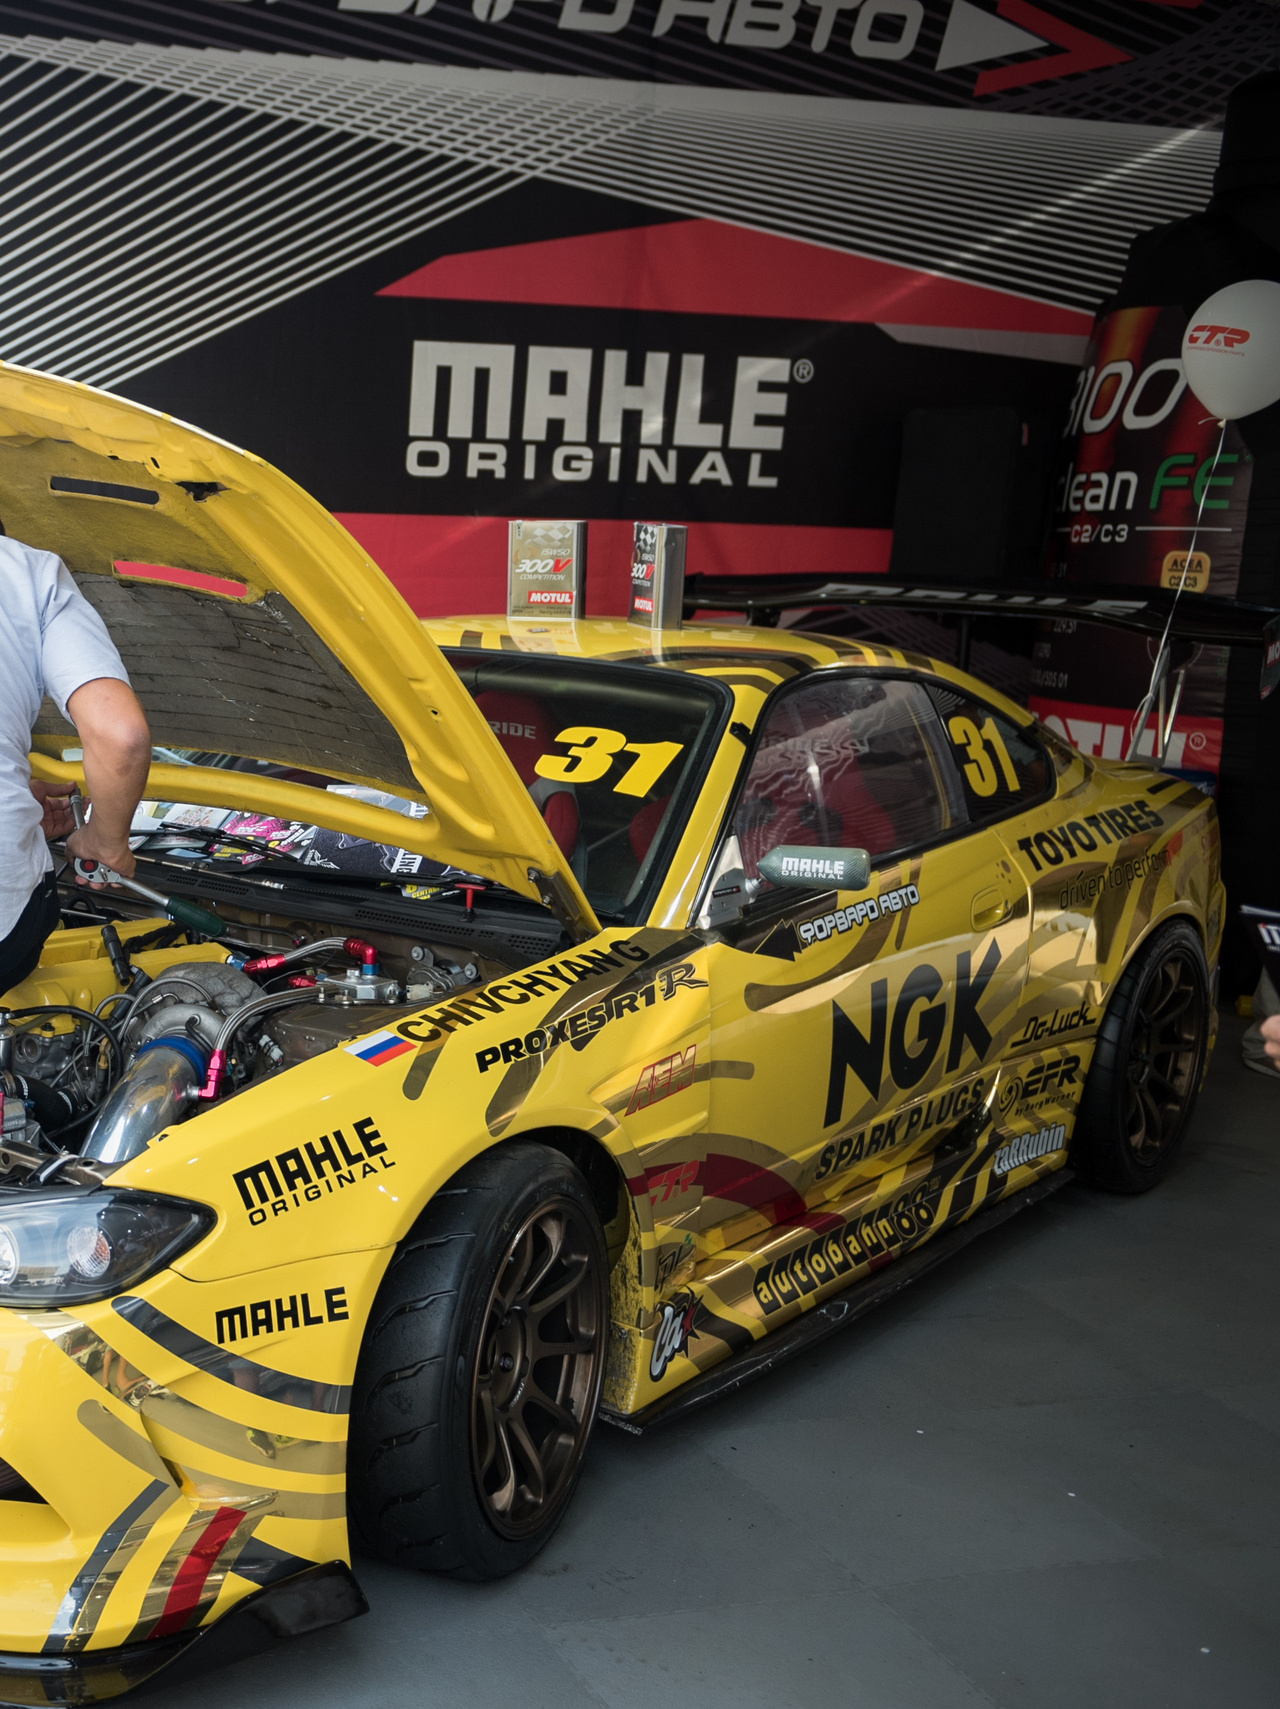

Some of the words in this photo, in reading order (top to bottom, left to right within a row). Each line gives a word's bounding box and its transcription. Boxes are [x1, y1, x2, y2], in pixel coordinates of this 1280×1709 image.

[409, 340, 791, 450] MAHLE
[406, 441, 778, 487] ORIGINAL
[515, 558, 573, 573] 300V
[1071, 524, 1129, 543] C2/C3
[530, 592, 571, 603] MOTUL
[534, 726, 684, 798] 31
[948, 716, 1020, 797] 31
[781, 857, 845, 875] MAHLE
[1017, 821, 1097, 872] TOYO
[1083, 800, 1165, 845] TIRES
[781, 869, 844, 880] ORIGINAL
[879, 884, 920, 916] АВТО
[1109, 866, 1123, 889] to
[475, 1003, 607, 1073] PROXES
[823, 936, 1002, 1128] NGK
[815, 1114, 904, 1180] SPARK
[903, 1077, 985, 1140] PLUGS
[232, 1116, 388, 1211] MAHLE
[249, 1156, 396, 1226] ORIGINAL
[215, 1286, 349, 1345] MAHLE
